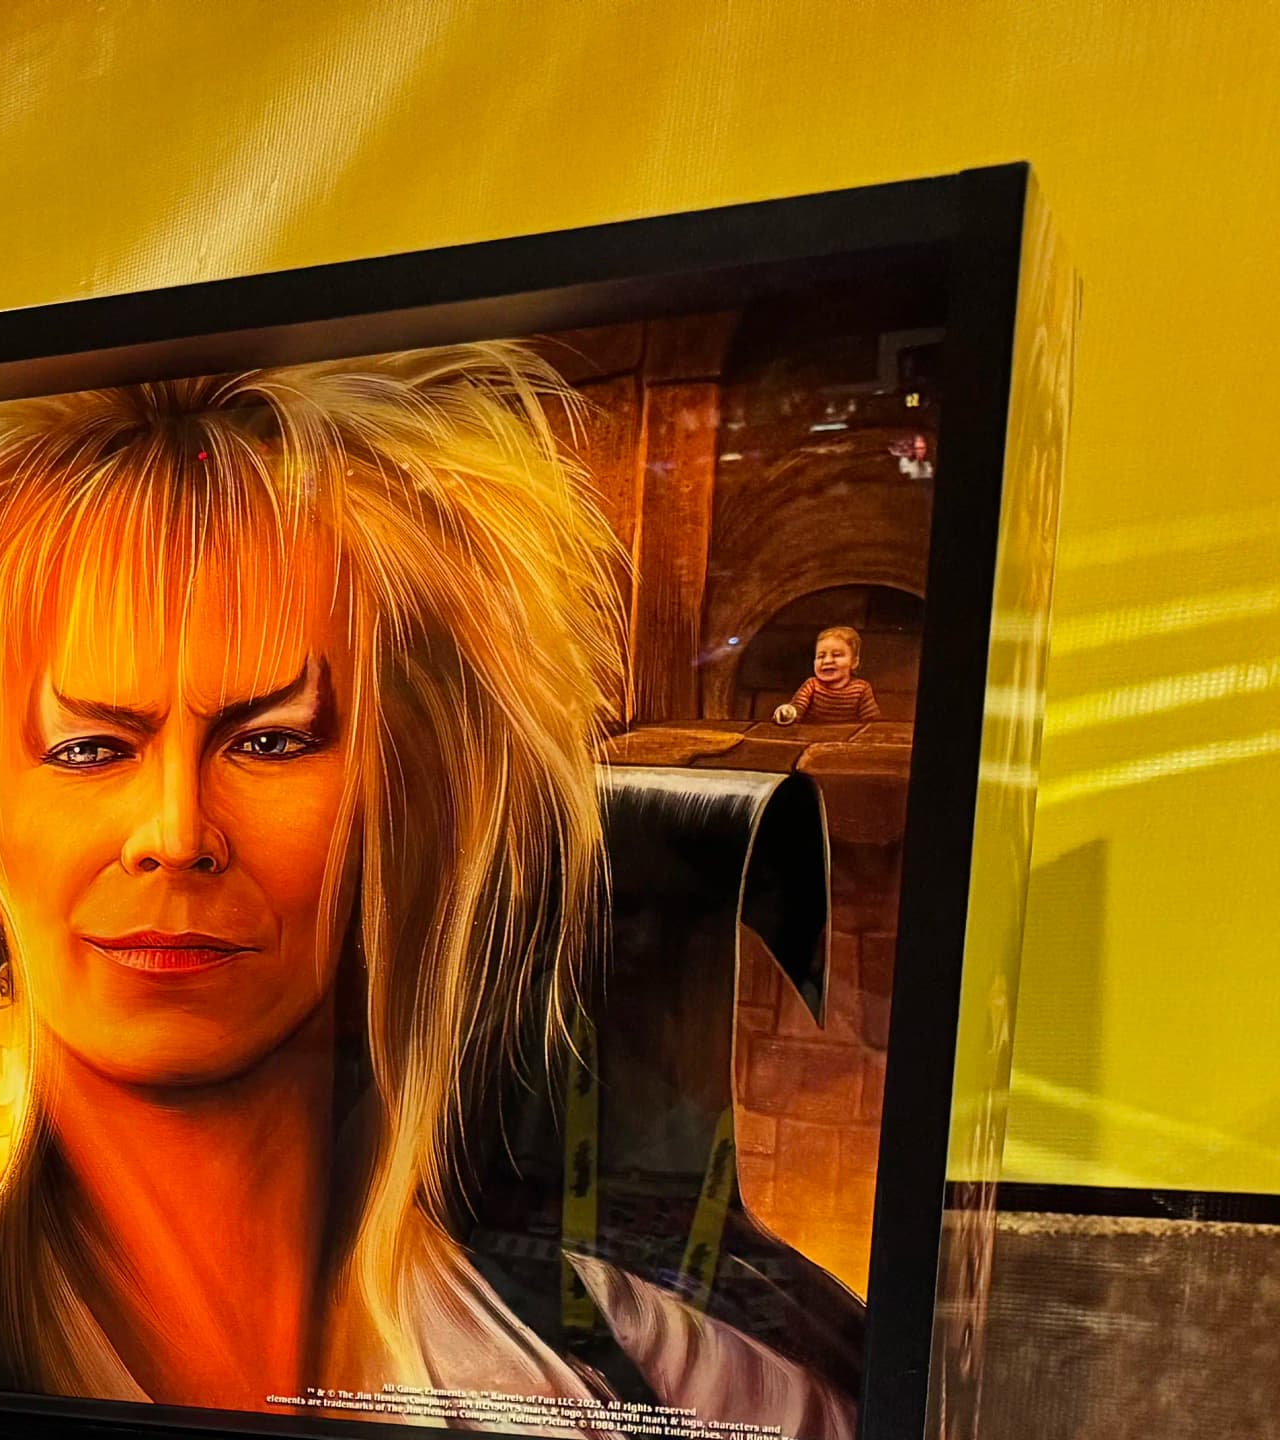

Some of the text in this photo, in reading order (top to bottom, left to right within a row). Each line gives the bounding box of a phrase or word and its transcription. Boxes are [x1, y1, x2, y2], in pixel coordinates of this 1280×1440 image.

[266, 1394, 306, 1405] elements
[307, 1398, 322, 1406] are
[323, 1399, 374, 1411] trademarks
[375, 1402, 386, 1412] of
[729, 1431, 744, 1440] All
[338, 1390, 354, 1399] The
[523, 1405, 549, 1415] mark
[643, 1415, 668, 1425] mark
[708, 1420, 759, 1432] characters
[762, 1424, 781, 1434] and
[490, 1391, 524, 1403] Barrels
[526, 1394, 536, 1403] of
[539, 1395, 555, 1405] Fun
[557, 1397, 574, 1406] LLC
[607, 1401, 621, 1410] All
[623, 1401, 652, 1415] rights
[654, 1404, 697, 1416] reserved
